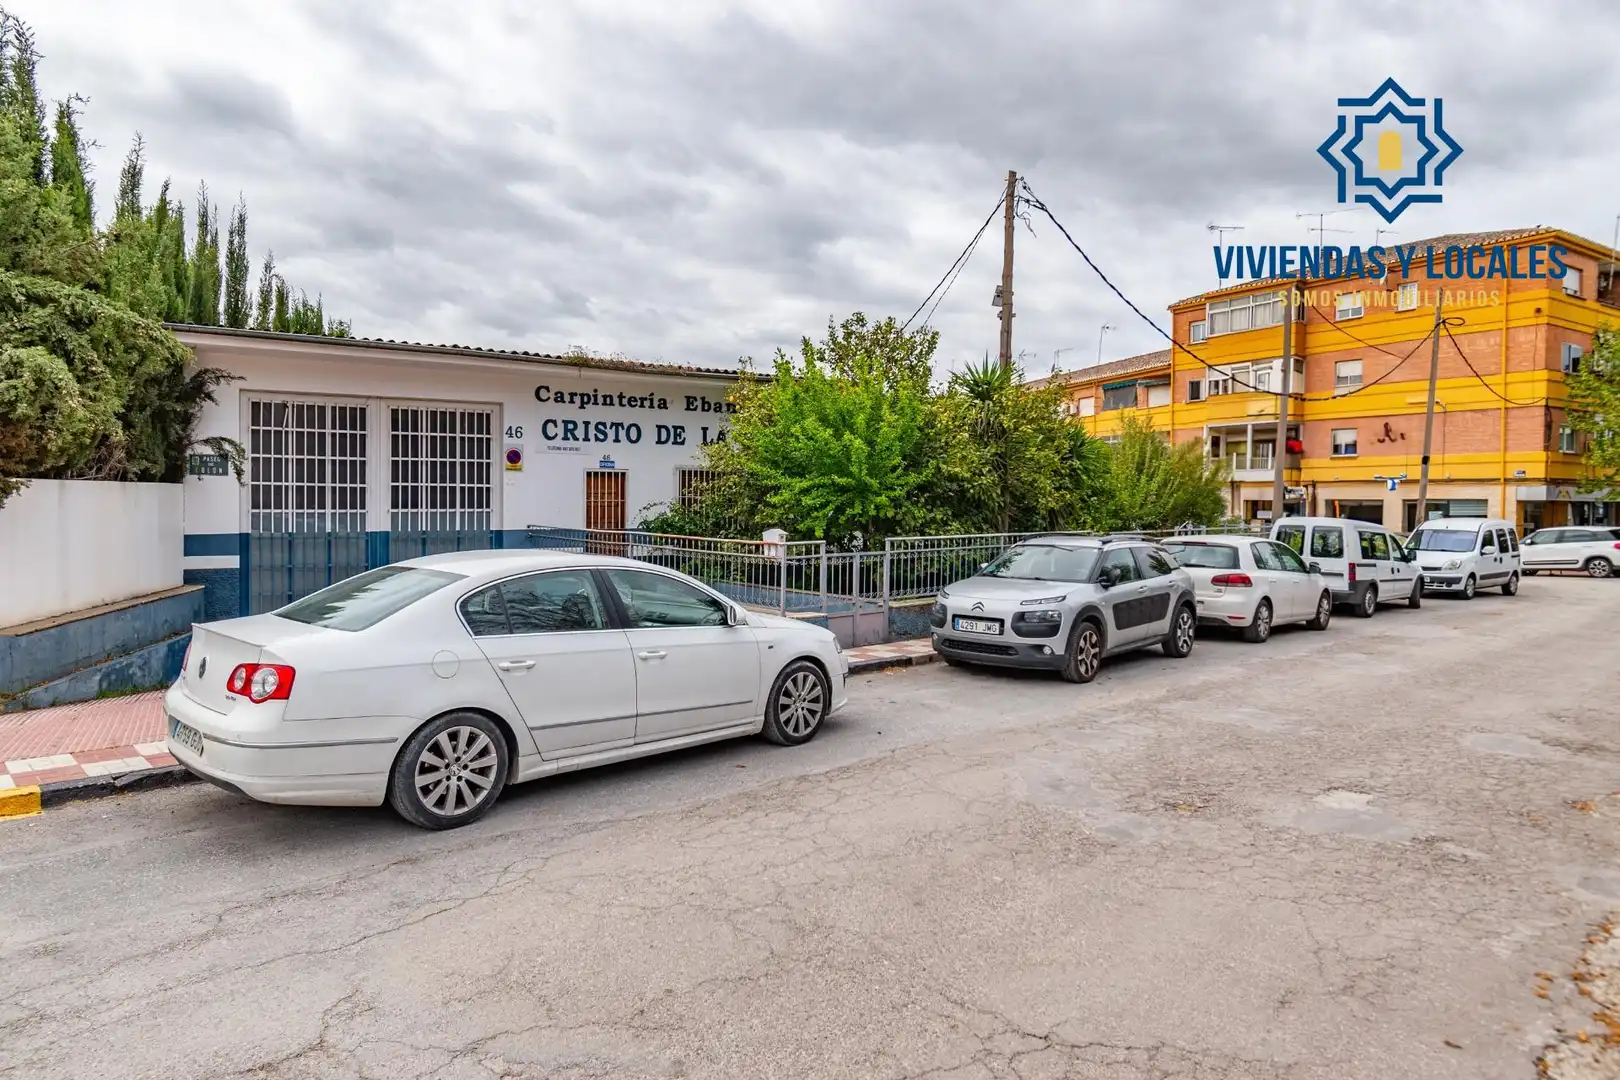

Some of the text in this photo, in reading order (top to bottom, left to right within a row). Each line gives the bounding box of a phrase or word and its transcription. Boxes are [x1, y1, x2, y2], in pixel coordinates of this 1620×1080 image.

[534, 385, 669, 410] Carpintería
[504, 425, 523, 439] 46
[541, 418, 642, 444] CRISTO
[655, 424, 686, 445] DE
[960, 620, 997, 633] 4291 JMG
